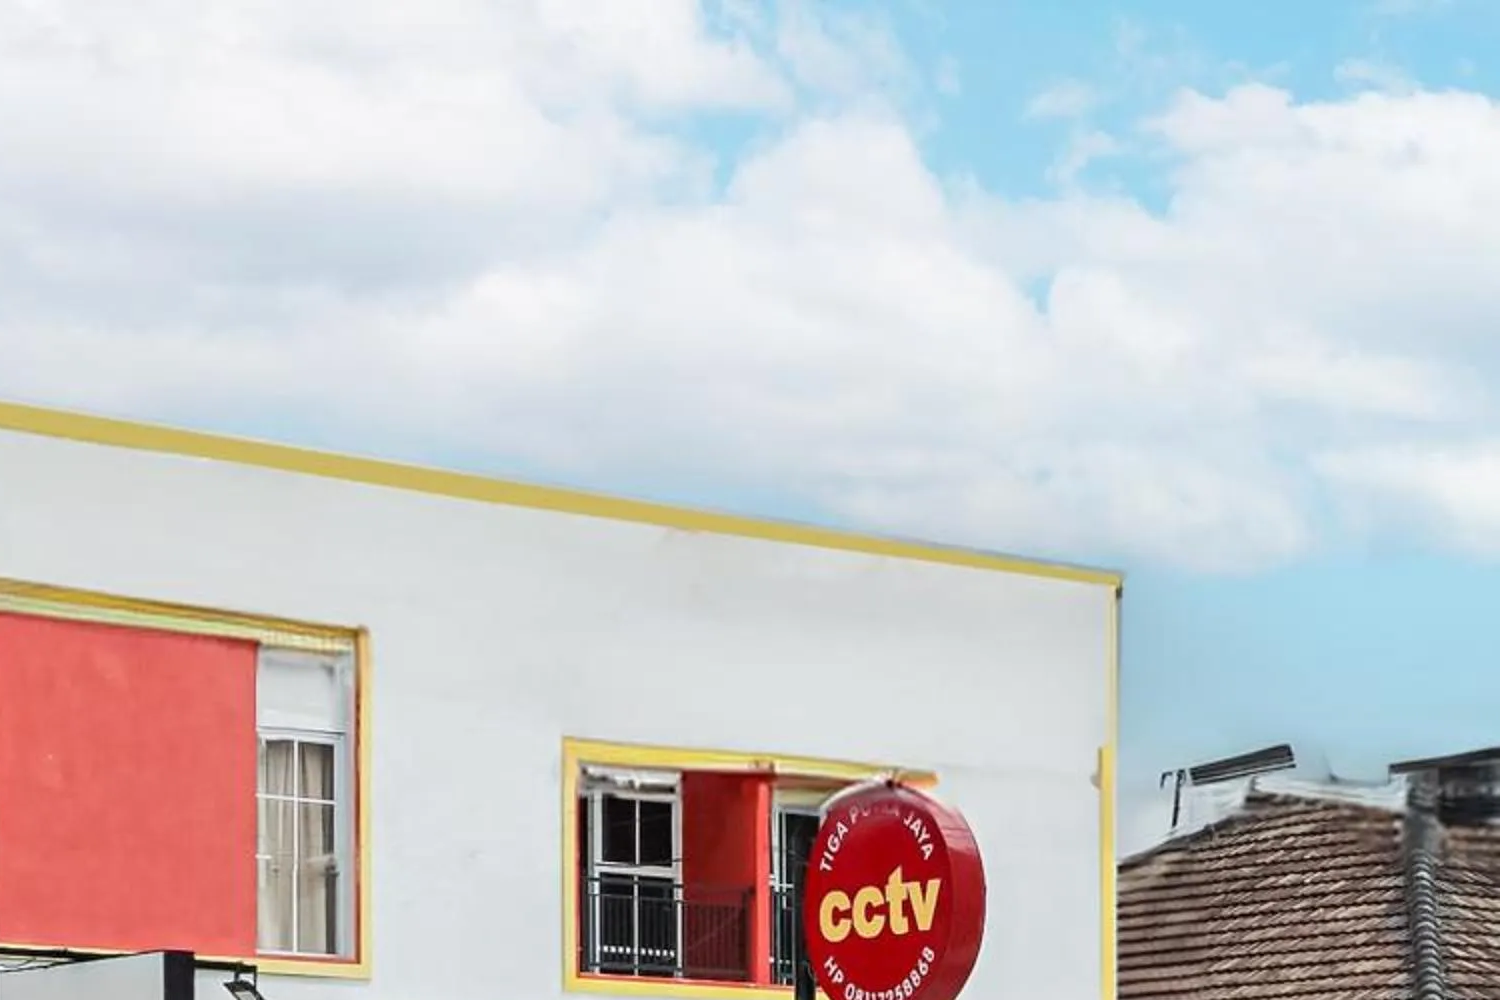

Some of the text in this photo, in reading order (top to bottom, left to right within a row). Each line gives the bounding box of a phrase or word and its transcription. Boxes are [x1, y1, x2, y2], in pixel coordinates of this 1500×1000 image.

[819, 821, 848, 871] TIGA
[902, 810, 934, 861] JAYA
[819, 865, 942, 942] cctv
[823, 955, 845, 984] HP
